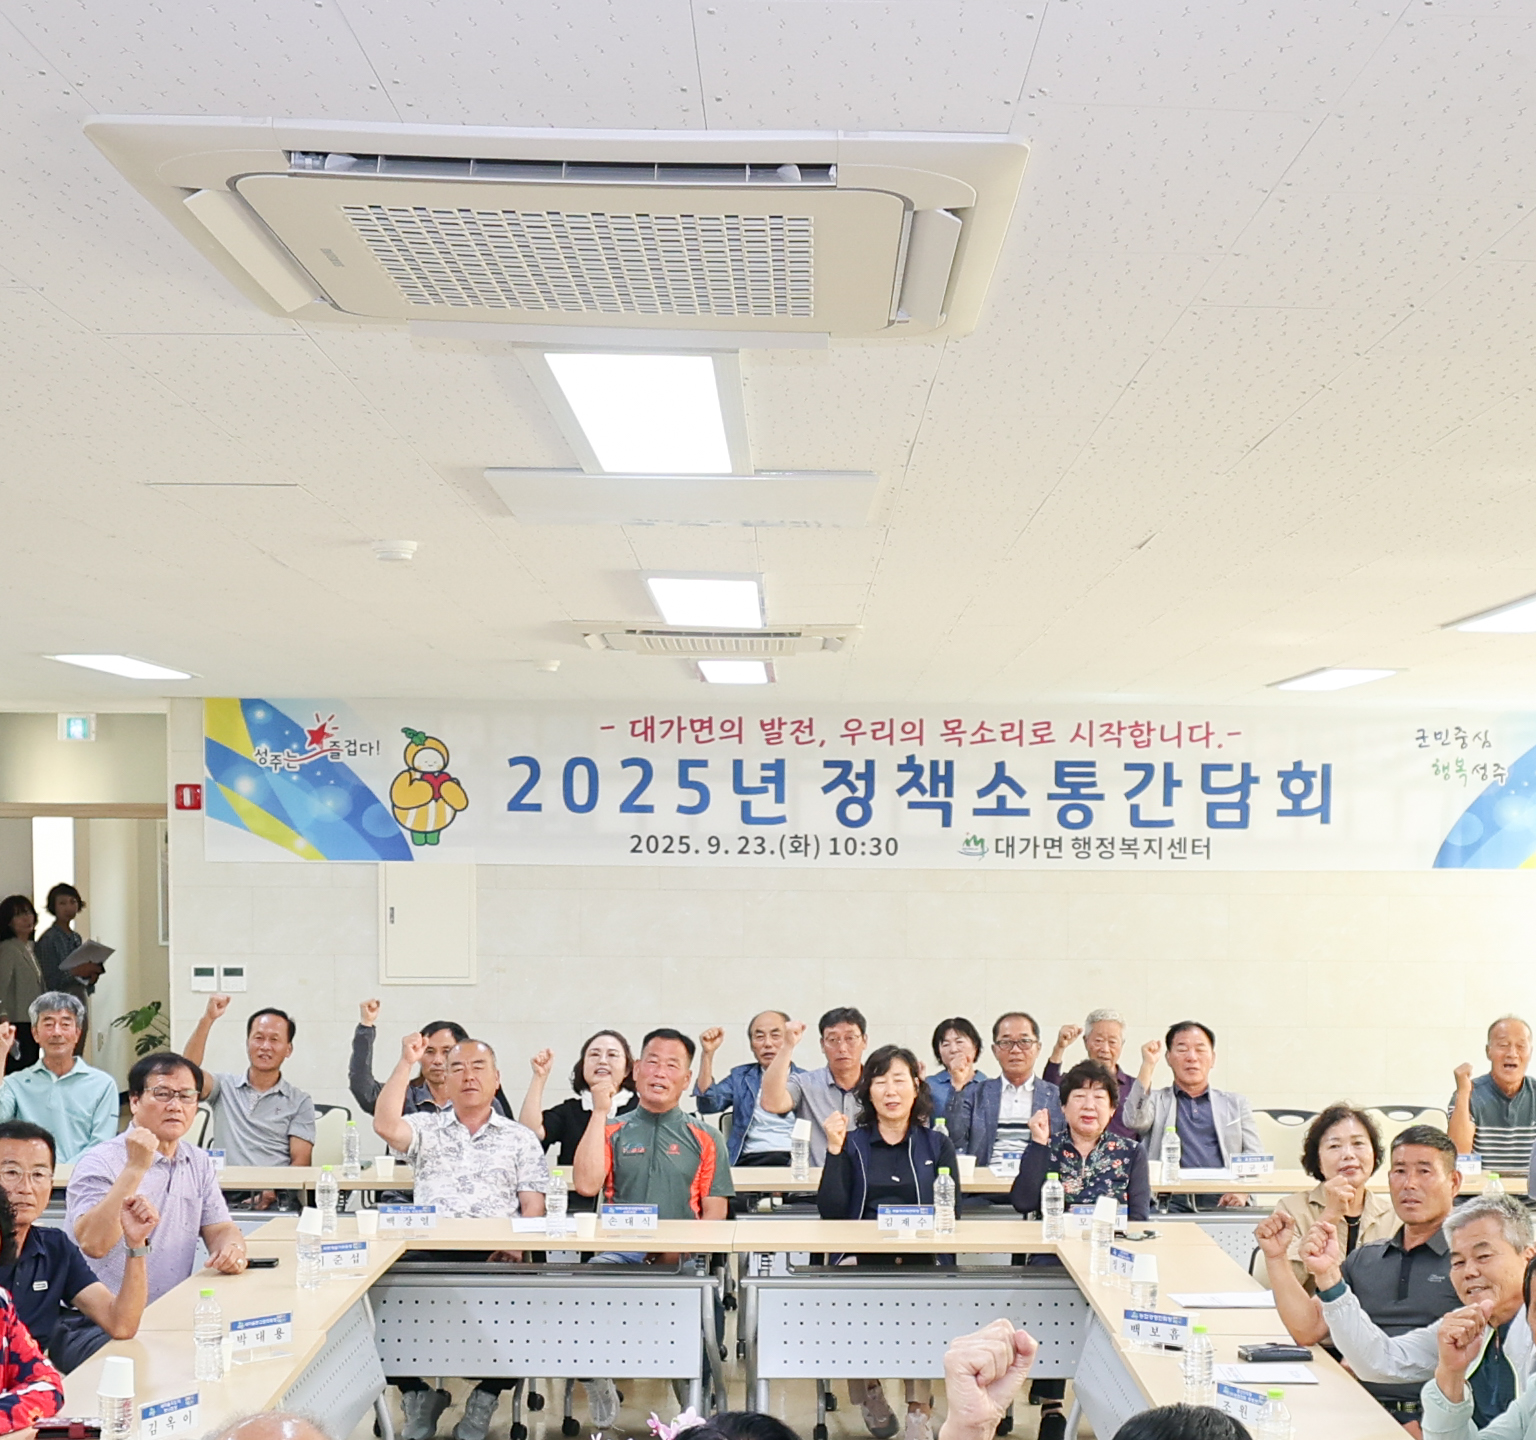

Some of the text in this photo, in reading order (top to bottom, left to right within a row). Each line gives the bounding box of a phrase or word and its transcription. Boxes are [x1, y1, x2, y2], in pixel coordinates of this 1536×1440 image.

[629, 715, 744, 745] 대가면의
[759, 716, 827, 748] 발전,
[839, 717, 925, 747] 우리의
[939, 718, 1057, 748] 목소리로
[1415, 726, 1492, 749] 군민중심
[254, 748, 298, 771] 성주는
[506, 754, 1332, 830] 2025년 정책소통간담회
[829, 836, 898, 857] 10:30
[994, 835, 1212, 860] 대가면 행정복지센터
[148, 1409, 192, 1436] 김옥이
